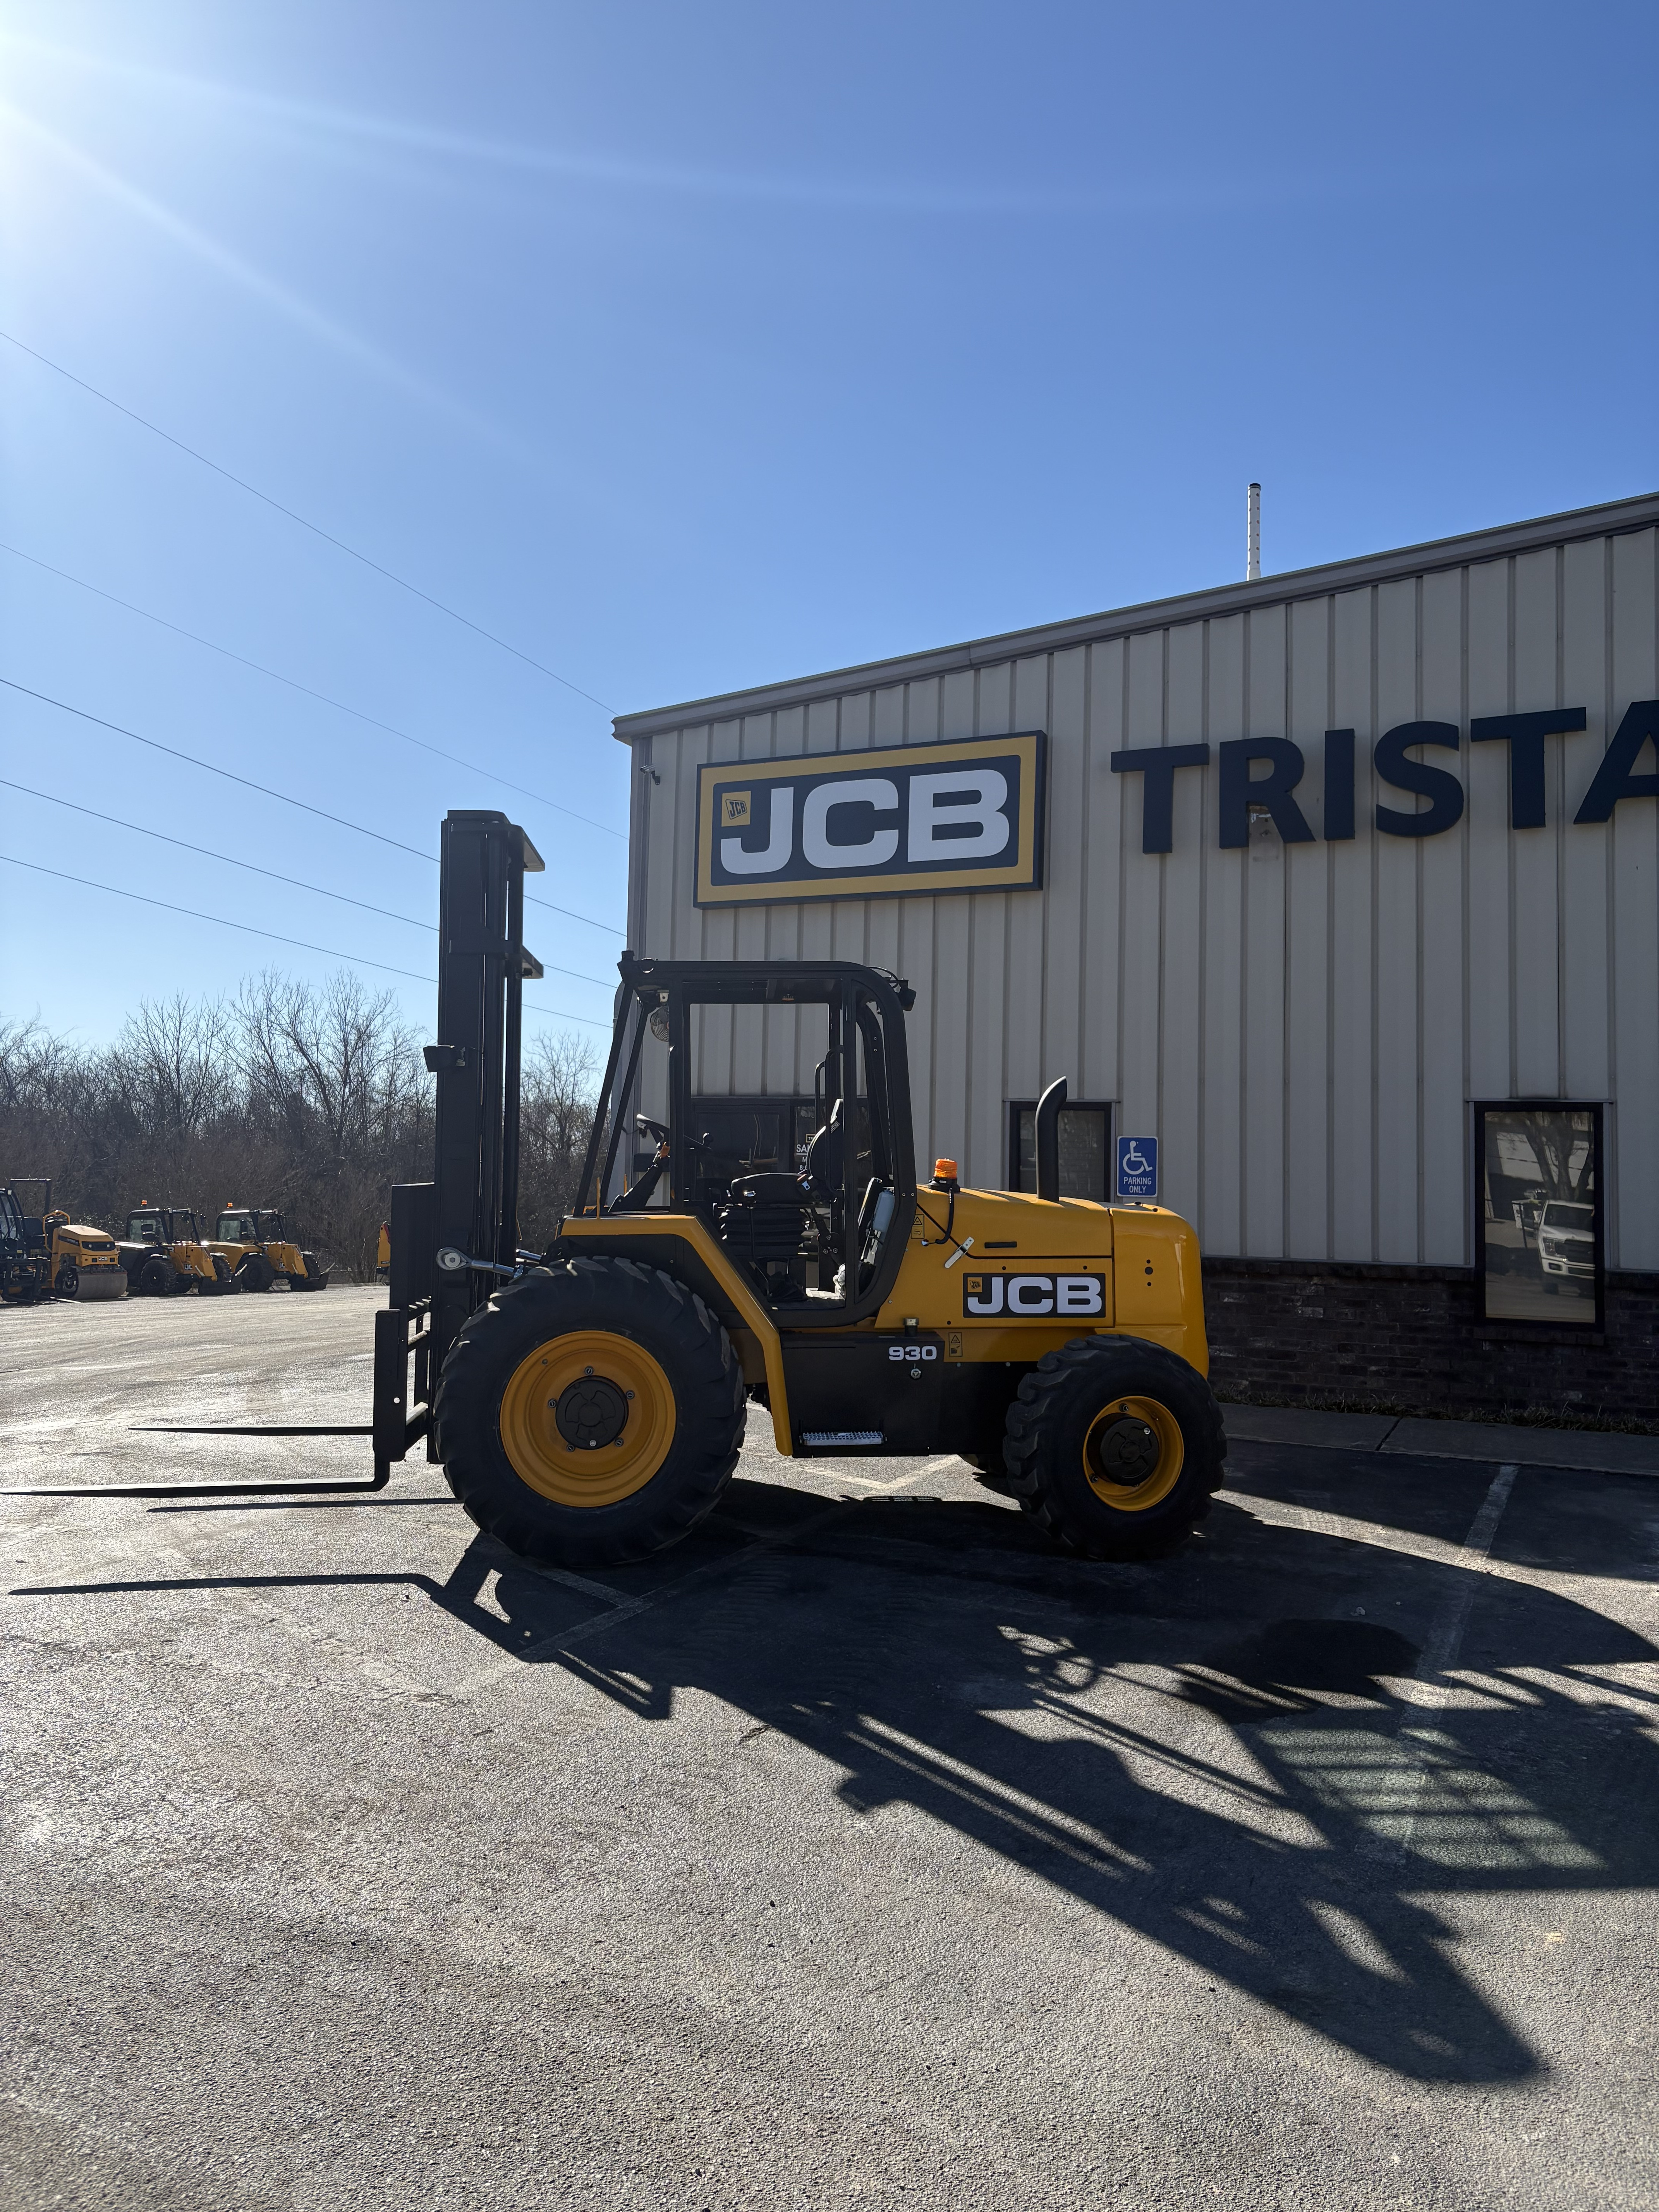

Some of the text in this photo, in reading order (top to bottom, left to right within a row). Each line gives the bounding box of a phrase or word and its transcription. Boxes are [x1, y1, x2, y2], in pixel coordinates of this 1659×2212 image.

[720, 769, 1010, 874] JCB
[729, 801, 746, 817] JCB
[967, 1276, 1102, 1314] JCB
[889, 1345, 937, 1360] 930
